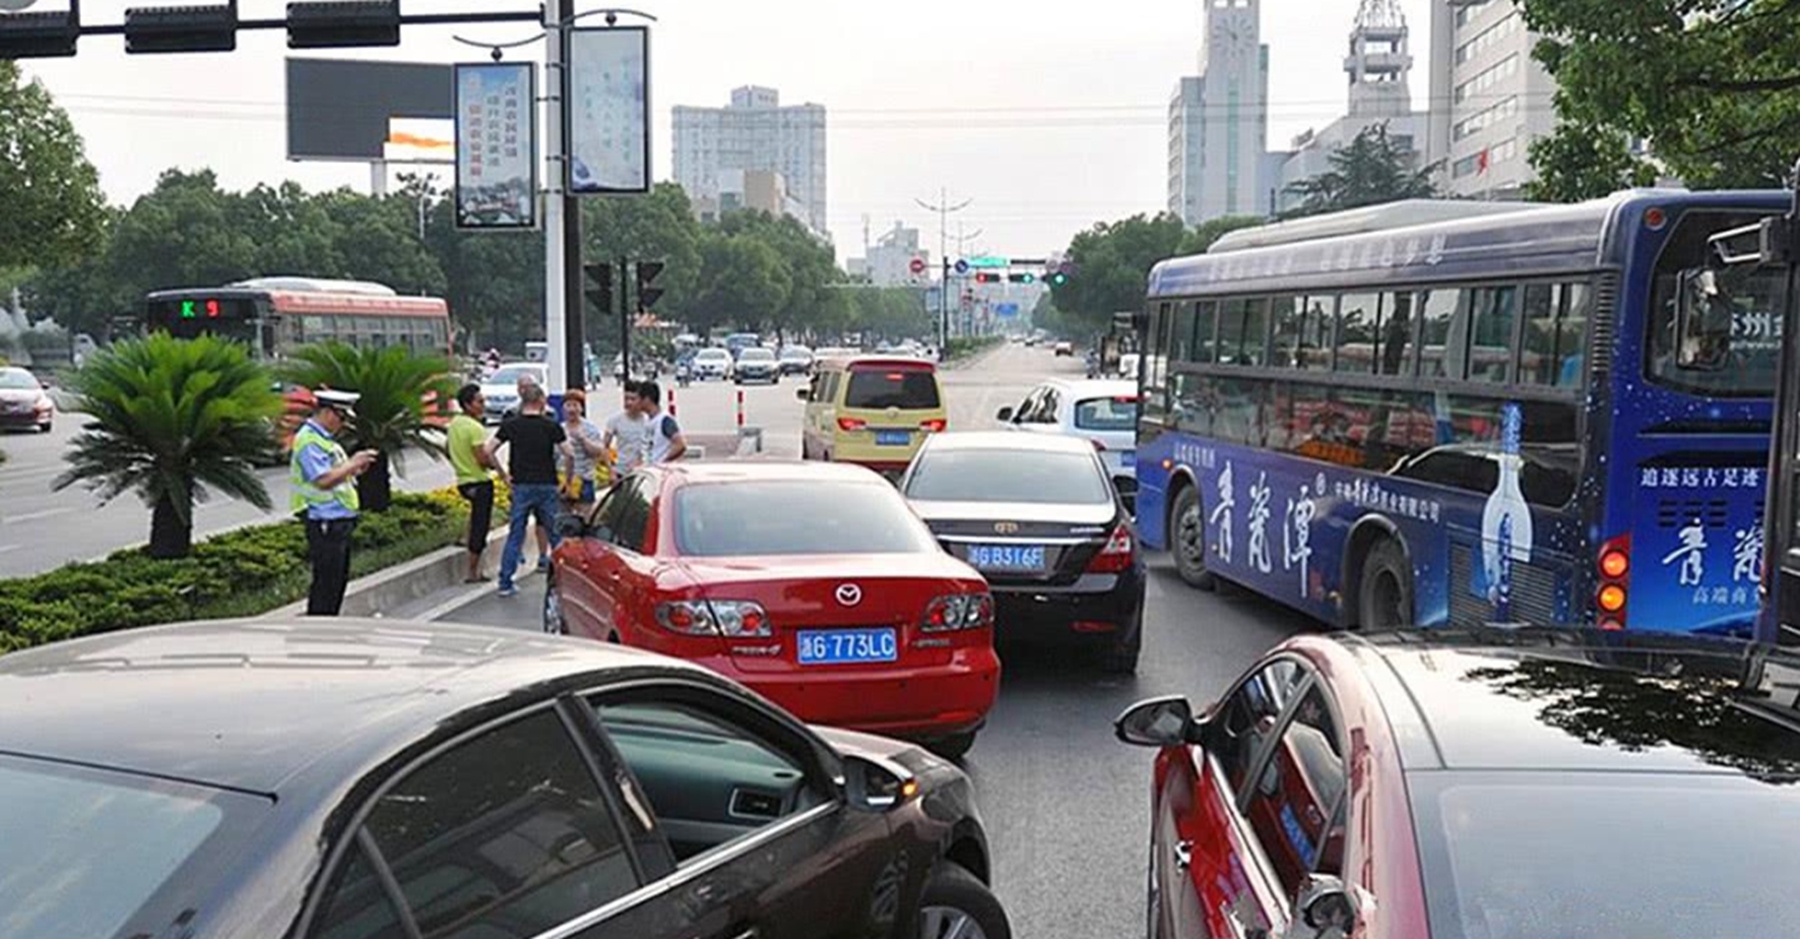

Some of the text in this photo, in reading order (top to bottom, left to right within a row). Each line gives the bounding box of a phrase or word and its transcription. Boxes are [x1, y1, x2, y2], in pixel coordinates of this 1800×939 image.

[1640, 466, 1759, 487] 追逐远古足迹
